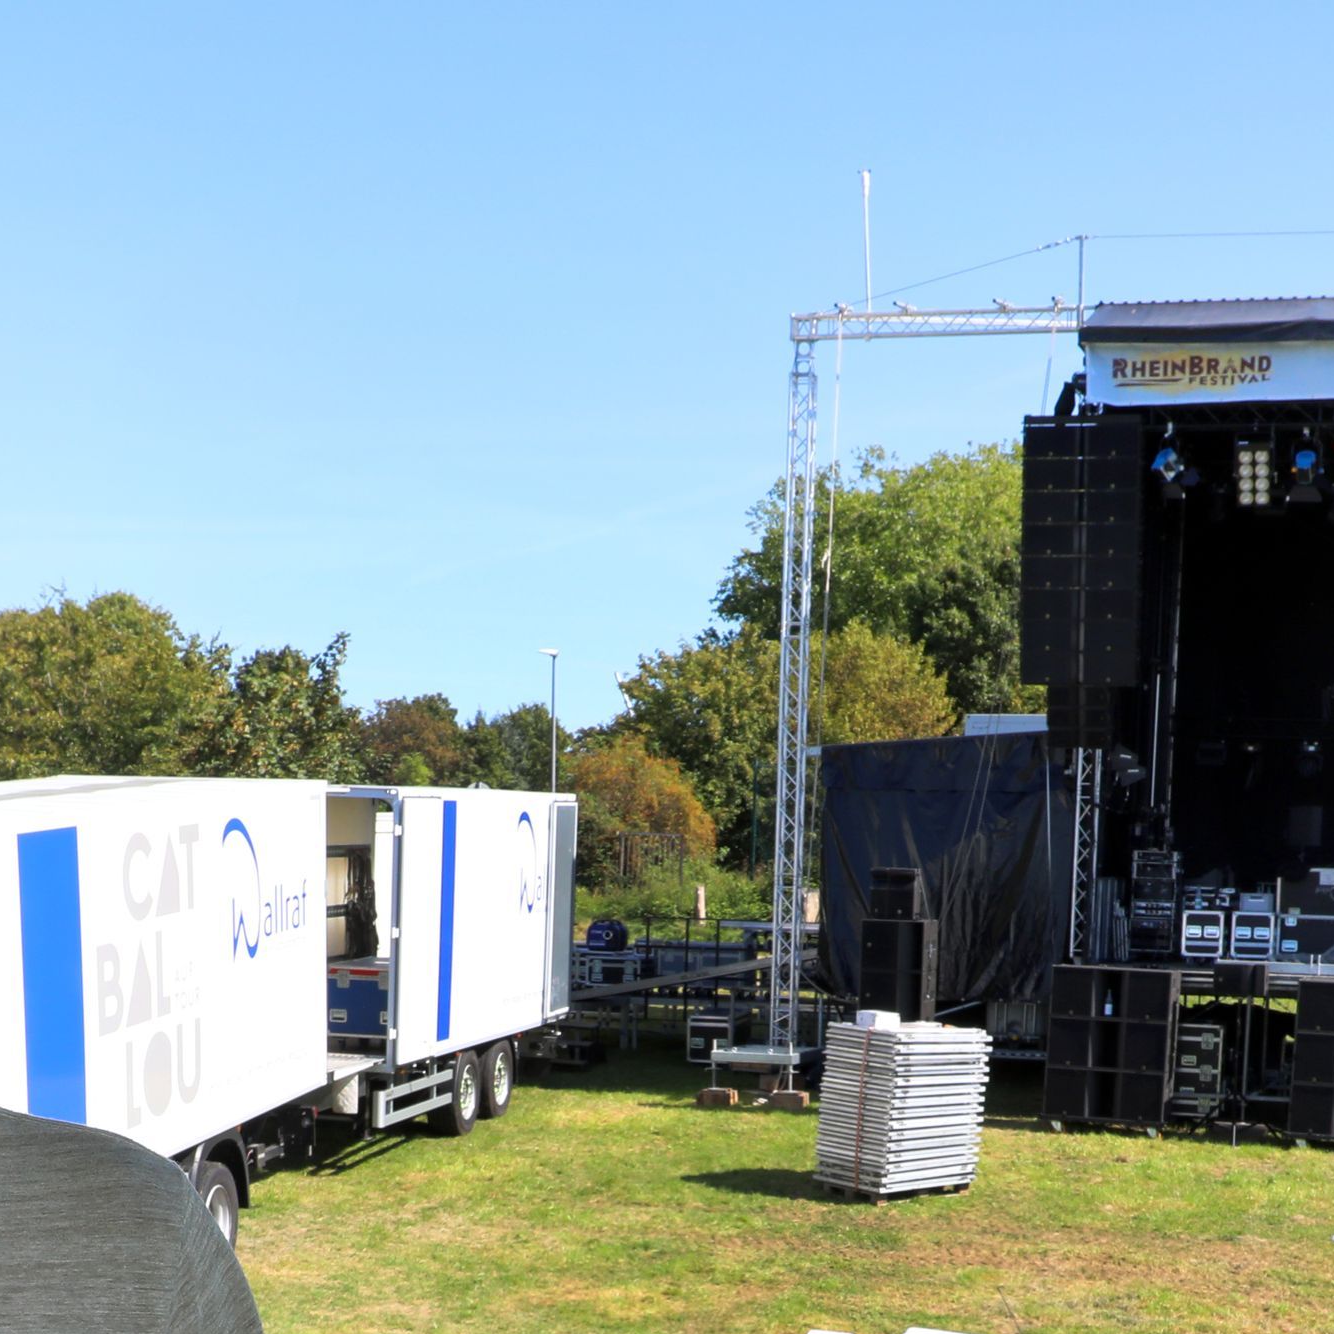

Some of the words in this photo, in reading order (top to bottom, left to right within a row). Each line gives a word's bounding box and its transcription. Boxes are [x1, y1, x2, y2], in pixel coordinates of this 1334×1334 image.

[1188, 373, 1271, 386] FESTIVAL
[122, 822, 200, 921] CAT
[221, 816, 313, 963] Wallraf
[95, 929, 172, 1038] BAL
[125, 1017, 202, 1129] LOU
